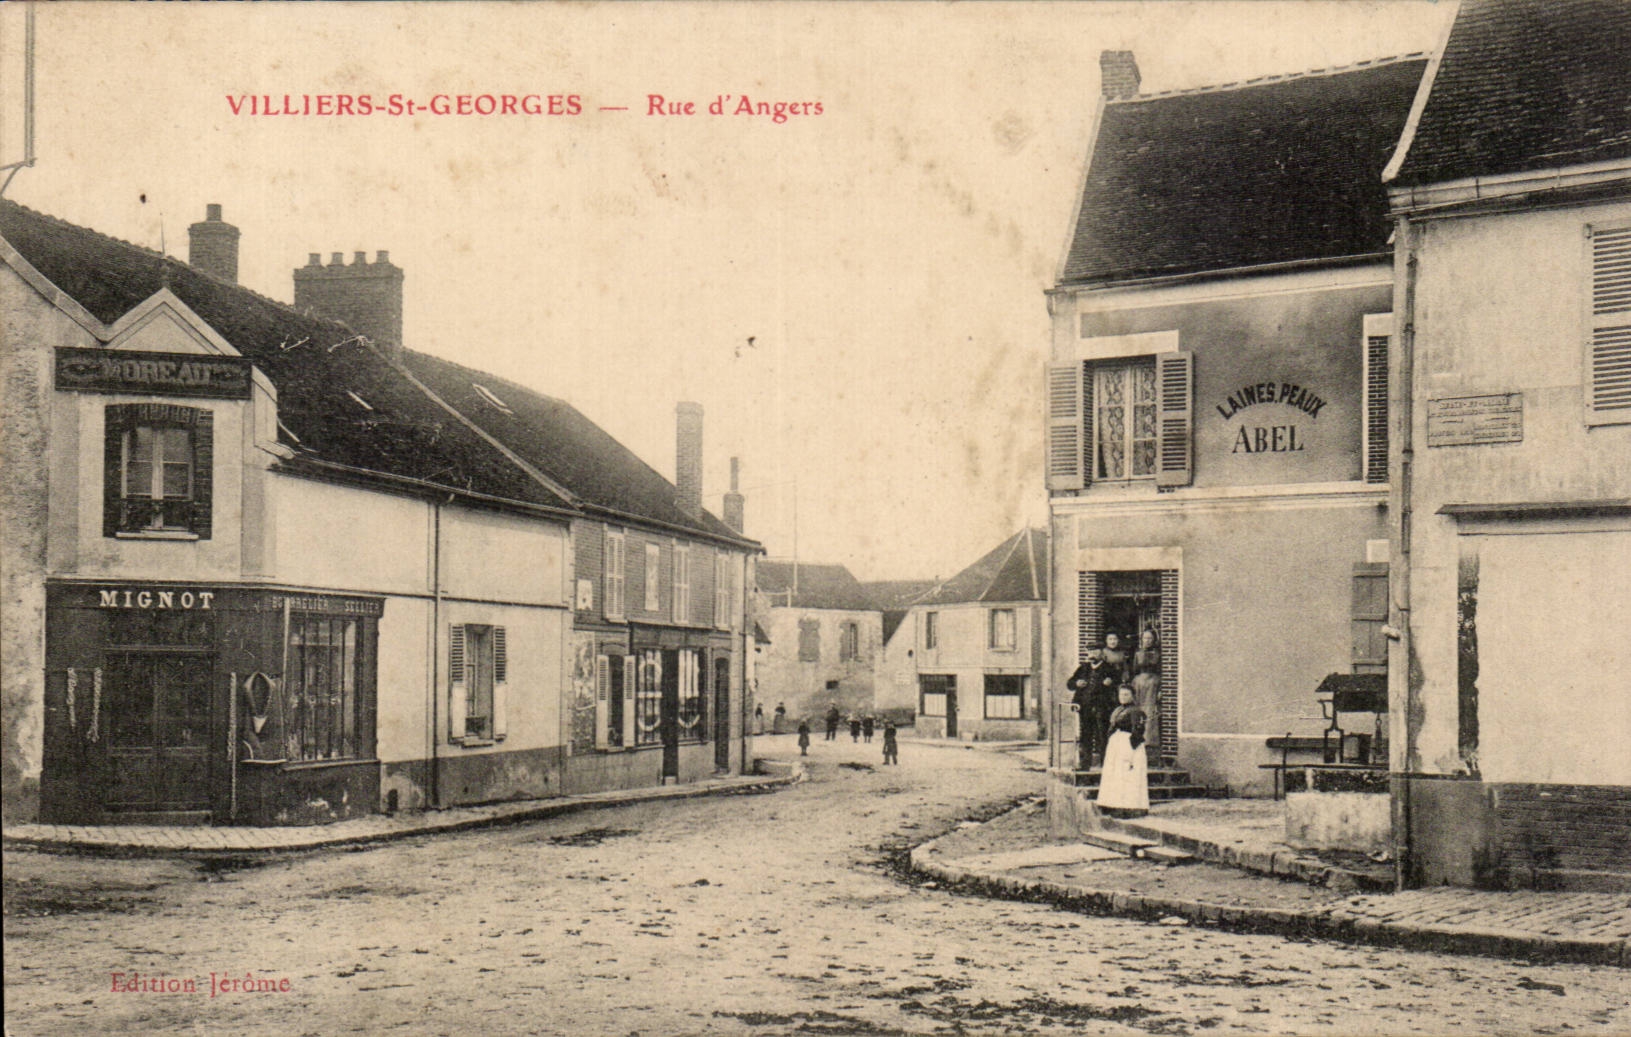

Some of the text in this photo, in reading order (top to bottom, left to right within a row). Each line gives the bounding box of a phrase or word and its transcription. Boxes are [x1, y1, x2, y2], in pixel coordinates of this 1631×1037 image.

[101, 357, 212, 386] MOREAU
[1279, 382, 1328, 419] PEAUX
[1231, 424, 1305, 454] ABEL
[99, 590, 215, 609] MIGNOT
